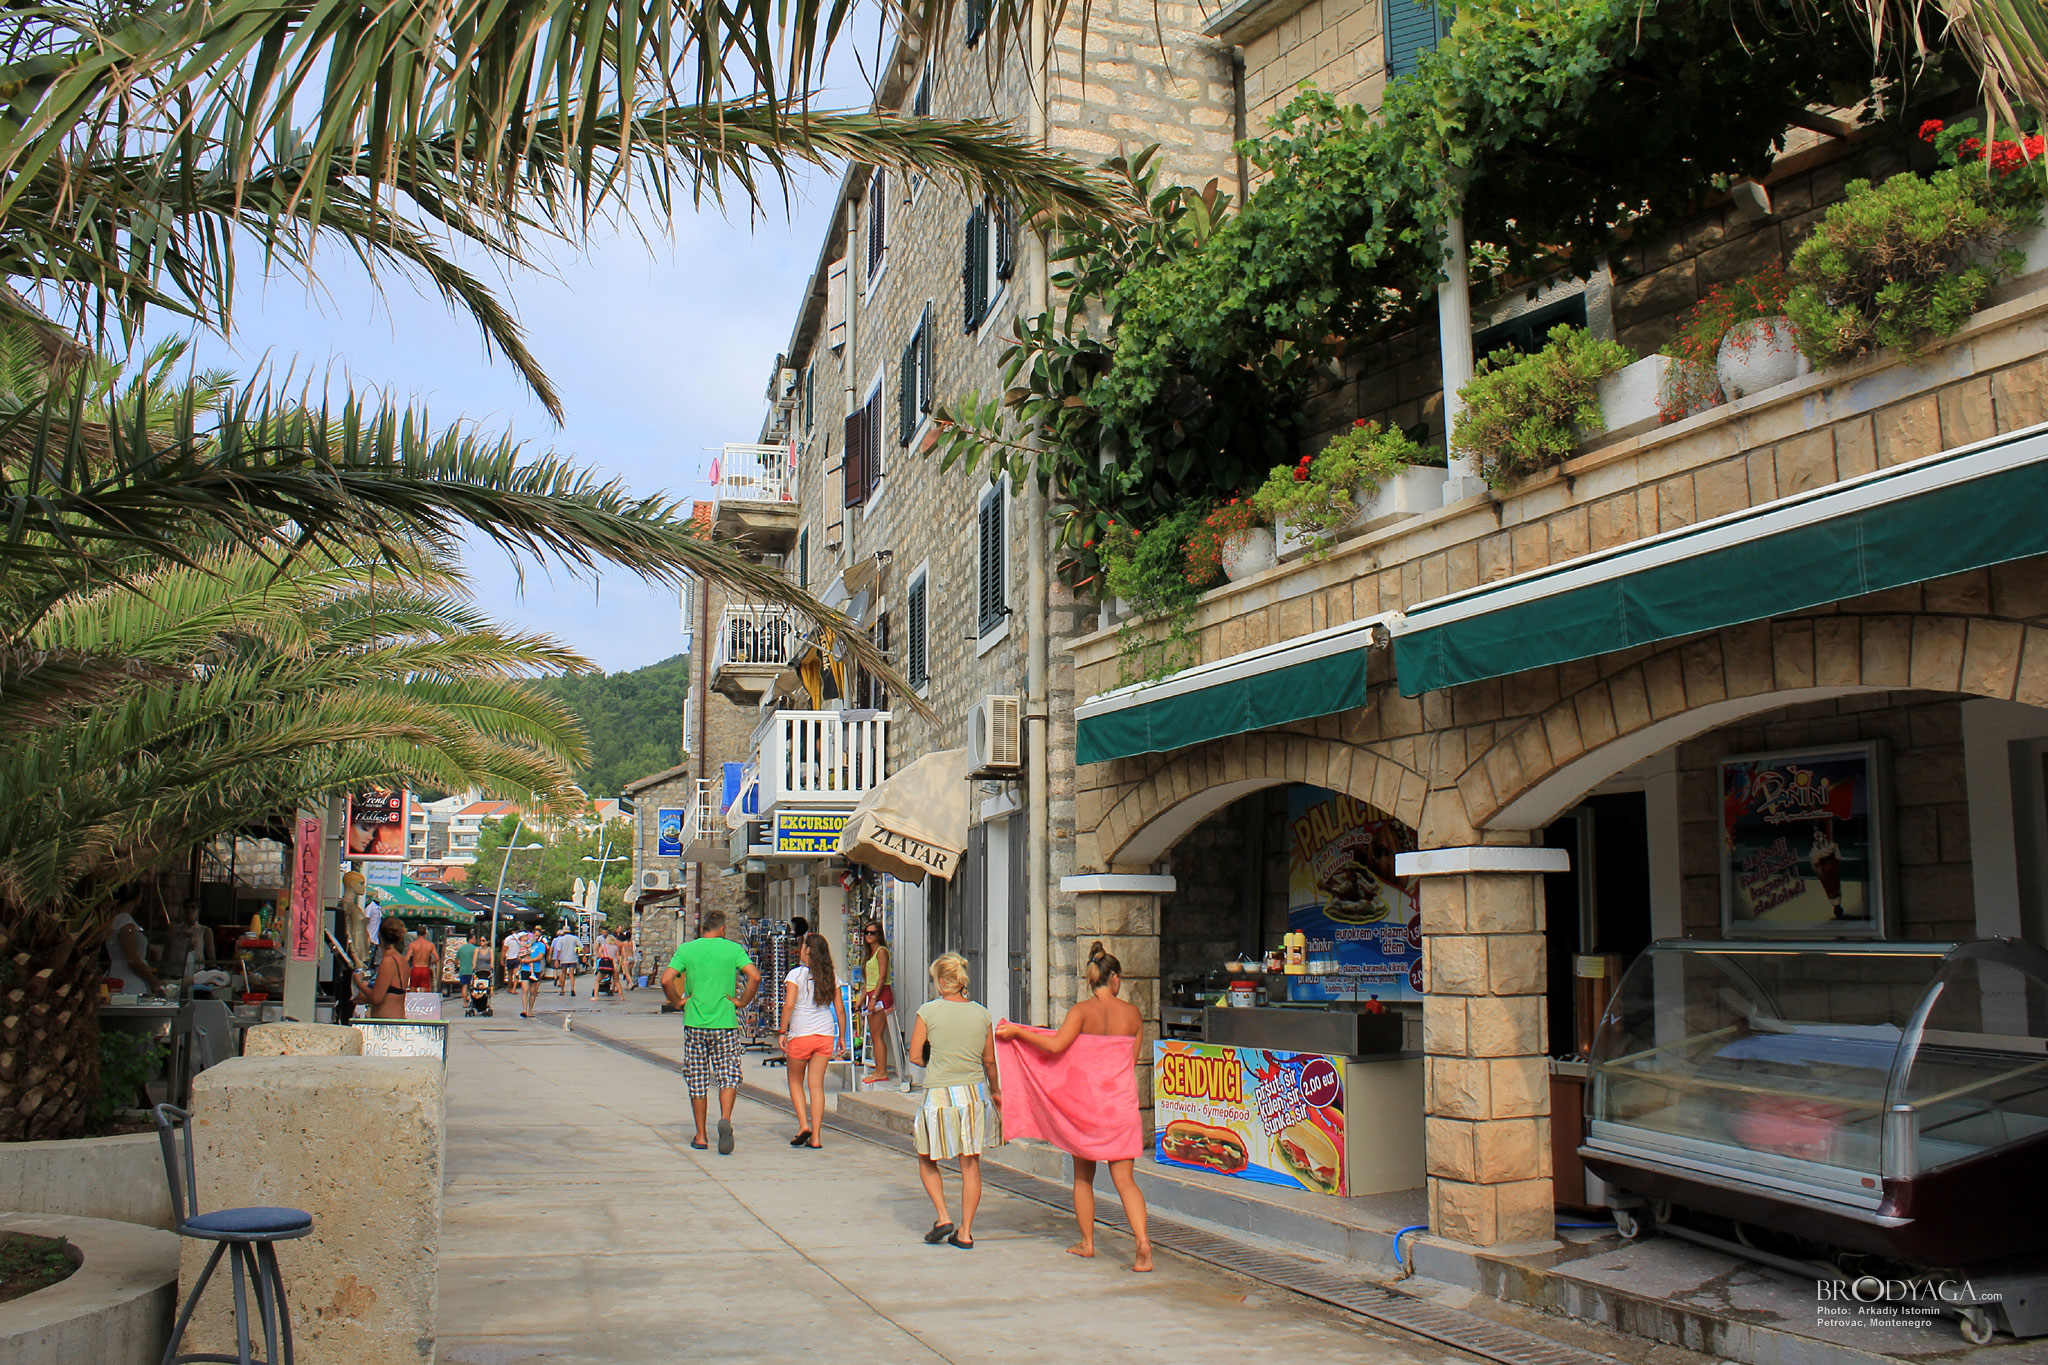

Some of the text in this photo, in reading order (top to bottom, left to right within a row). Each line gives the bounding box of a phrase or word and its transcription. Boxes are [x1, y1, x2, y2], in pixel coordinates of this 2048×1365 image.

[870, 824, 948, 871] ZLATAR
[1316, 833, 1372, 873] pan cakes
[1335, 926, 1372, 940] eurokrem
[1380, 925, 1408, 942] plazma
[1382, 940, 1405, 955] džem
[1162, 1048, 1242, 1103] SENDVIČI
[1284, 1068, 1297, 1087] sir
[1302, 1071, 1335, 1097] 2,00 eur
[1161, 1100, 1197, 1114] sandwich
[1202, 1104, 1250, 1121] бутерброд
[1294, 1101, 1308, 1122] sir
